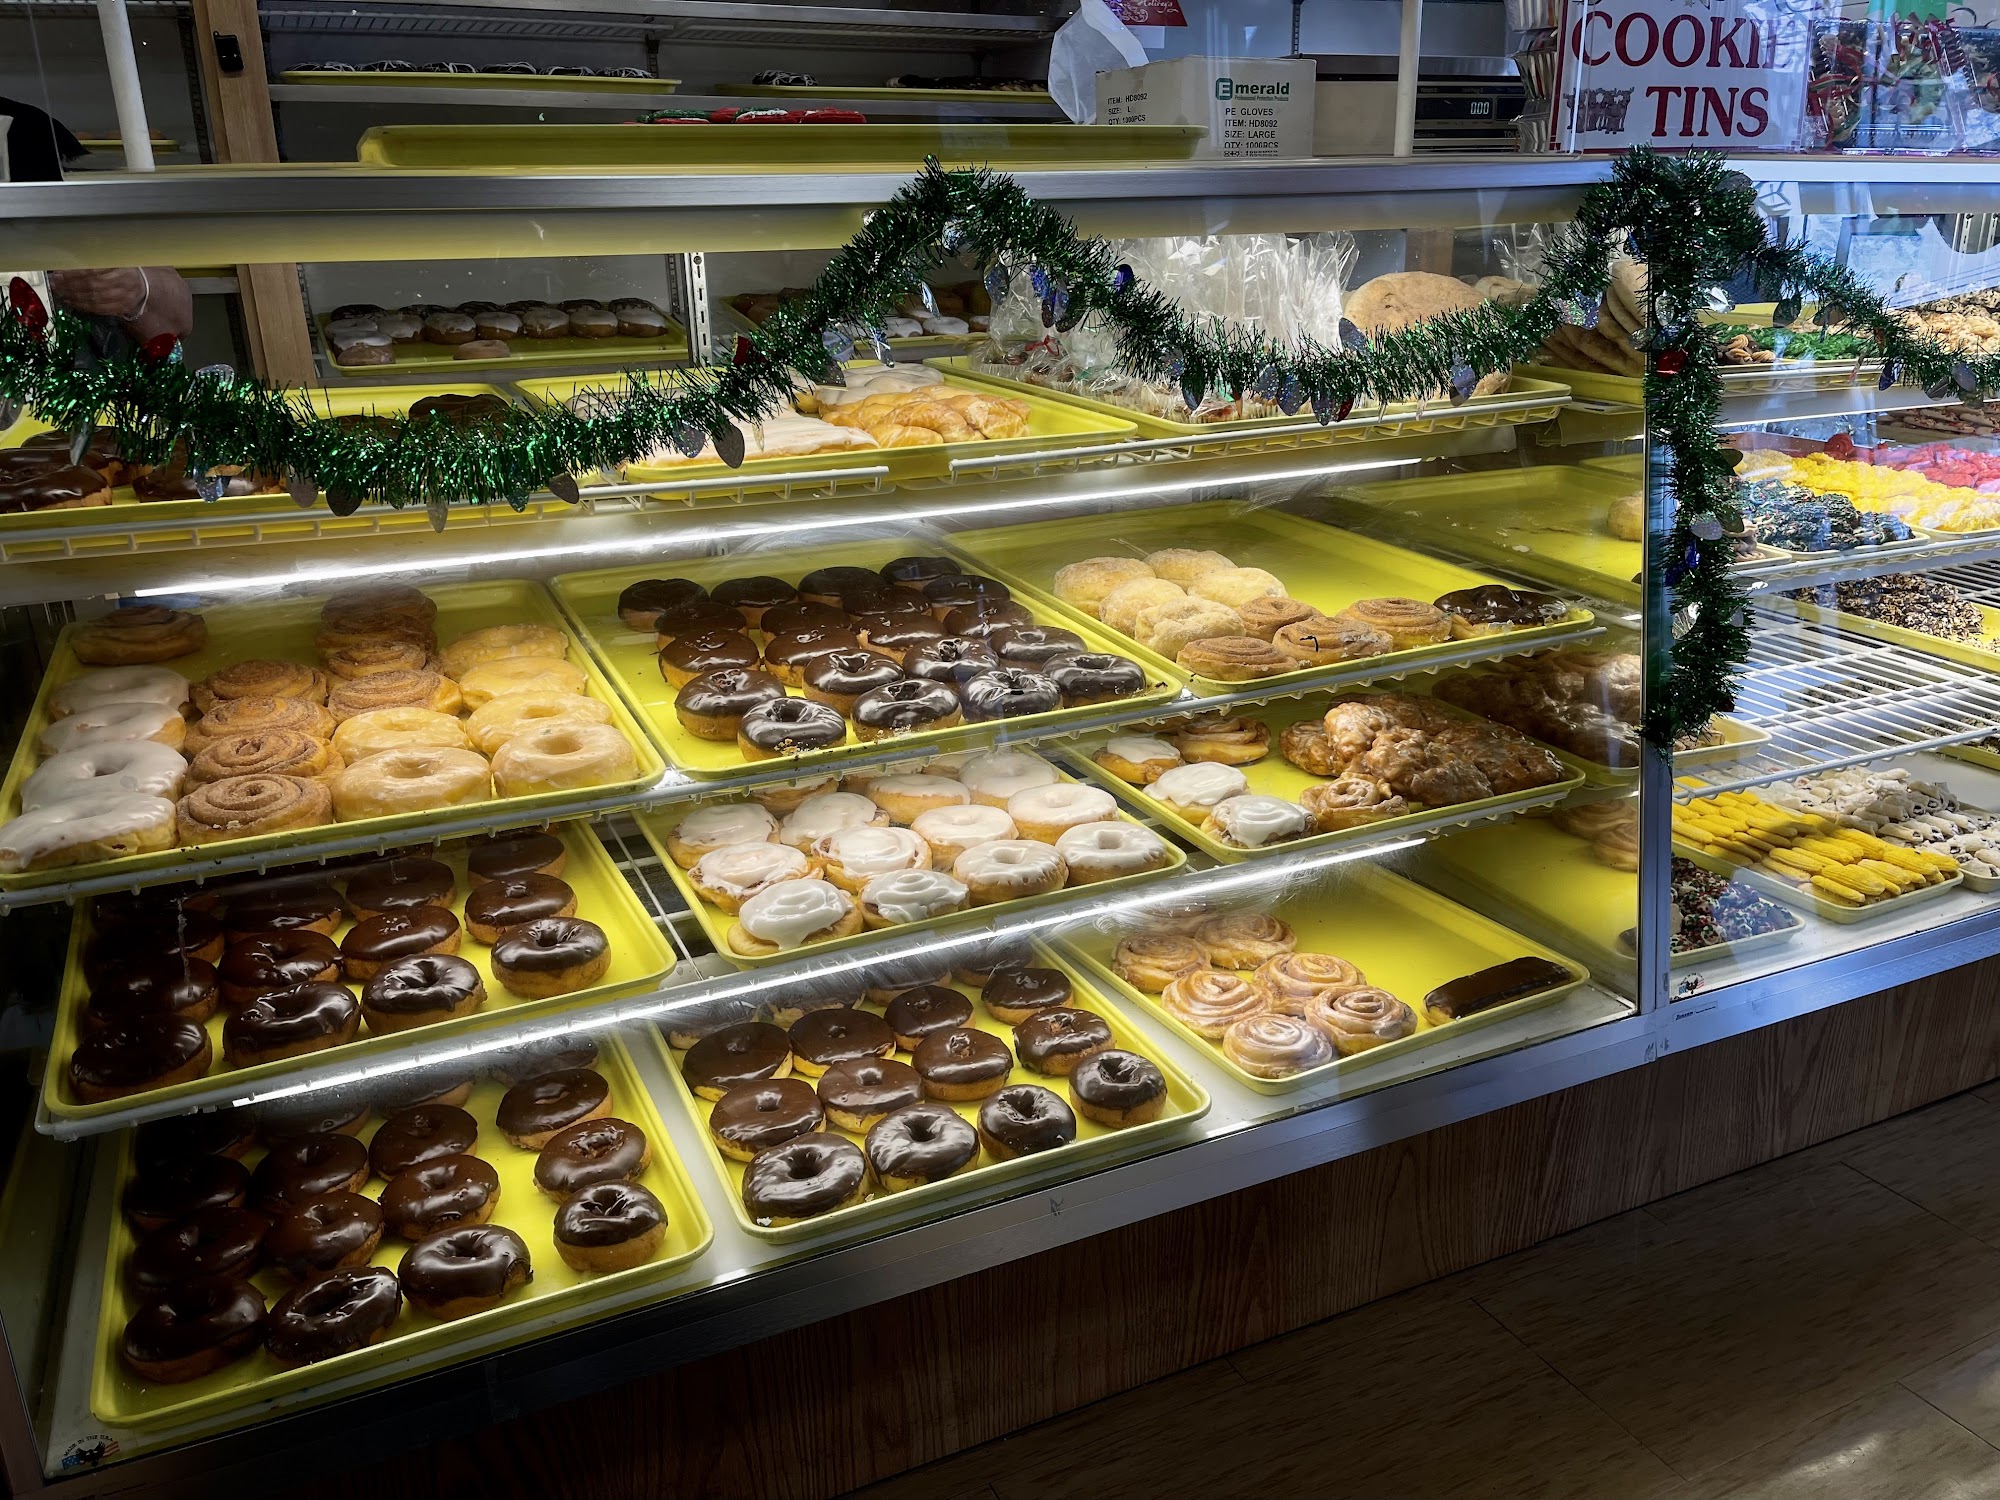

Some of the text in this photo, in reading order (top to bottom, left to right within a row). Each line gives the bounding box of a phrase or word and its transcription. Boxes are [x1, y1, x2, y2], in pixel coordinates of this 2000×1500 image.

[1216, 78, 1290, 100] Emerald
[1107, 96, 1123, 105] ITEM:
[1108, 105, 1131, 116] SIZE: L
[1225, 107, 1274, 116] PE GLOVES
[1646, 86, 1769, 138] TINS
[1225, 119, 1278, 128] ITEM: HD8092
[1224, 130, 1276, 139] SIZE: LARGE
